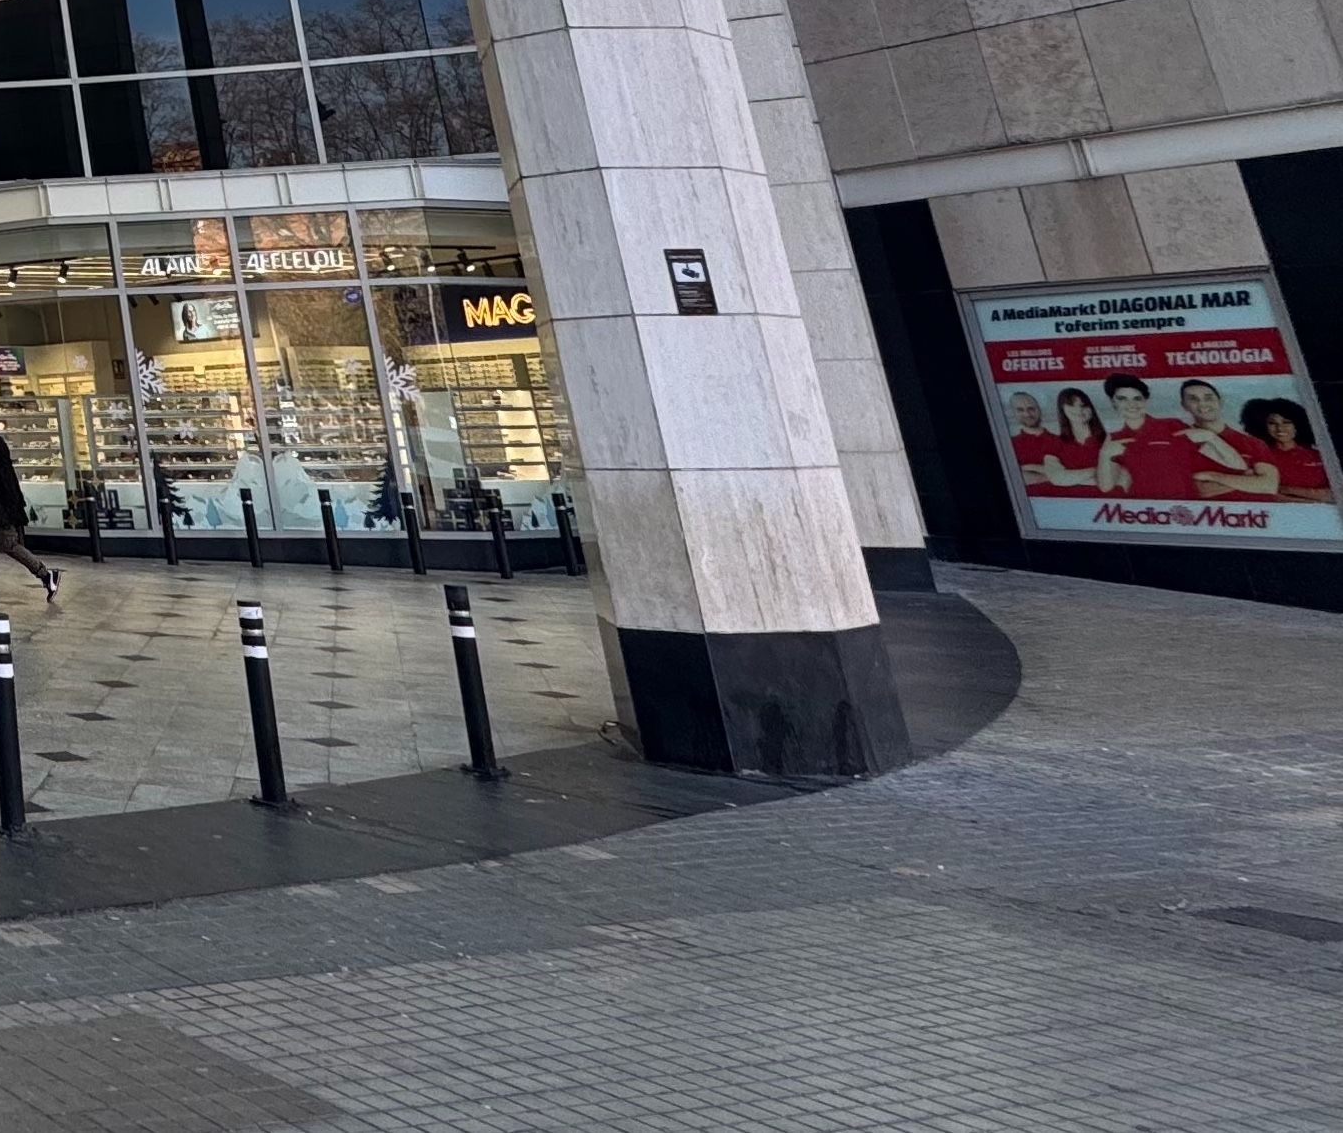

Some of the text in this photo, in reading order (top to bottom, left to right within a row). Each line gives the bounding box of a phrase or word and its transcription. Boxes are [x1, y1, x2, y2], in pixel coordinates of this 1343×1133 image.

[141, 250, 345, 276] ALAIN AFFLELOU
[991, 290, 1251, 322] A MediaMarkt DIAGONAL MAR
[1122, 316, 1186, 331] sempre
[1002, 356, 1065, 371] OFERTES
[1083, 353, 1147, 369] SERVEIS
[1164, 348, 1275, 365] TECNOLOGIA
[1092, 503, 1270, 529] Media Markt
